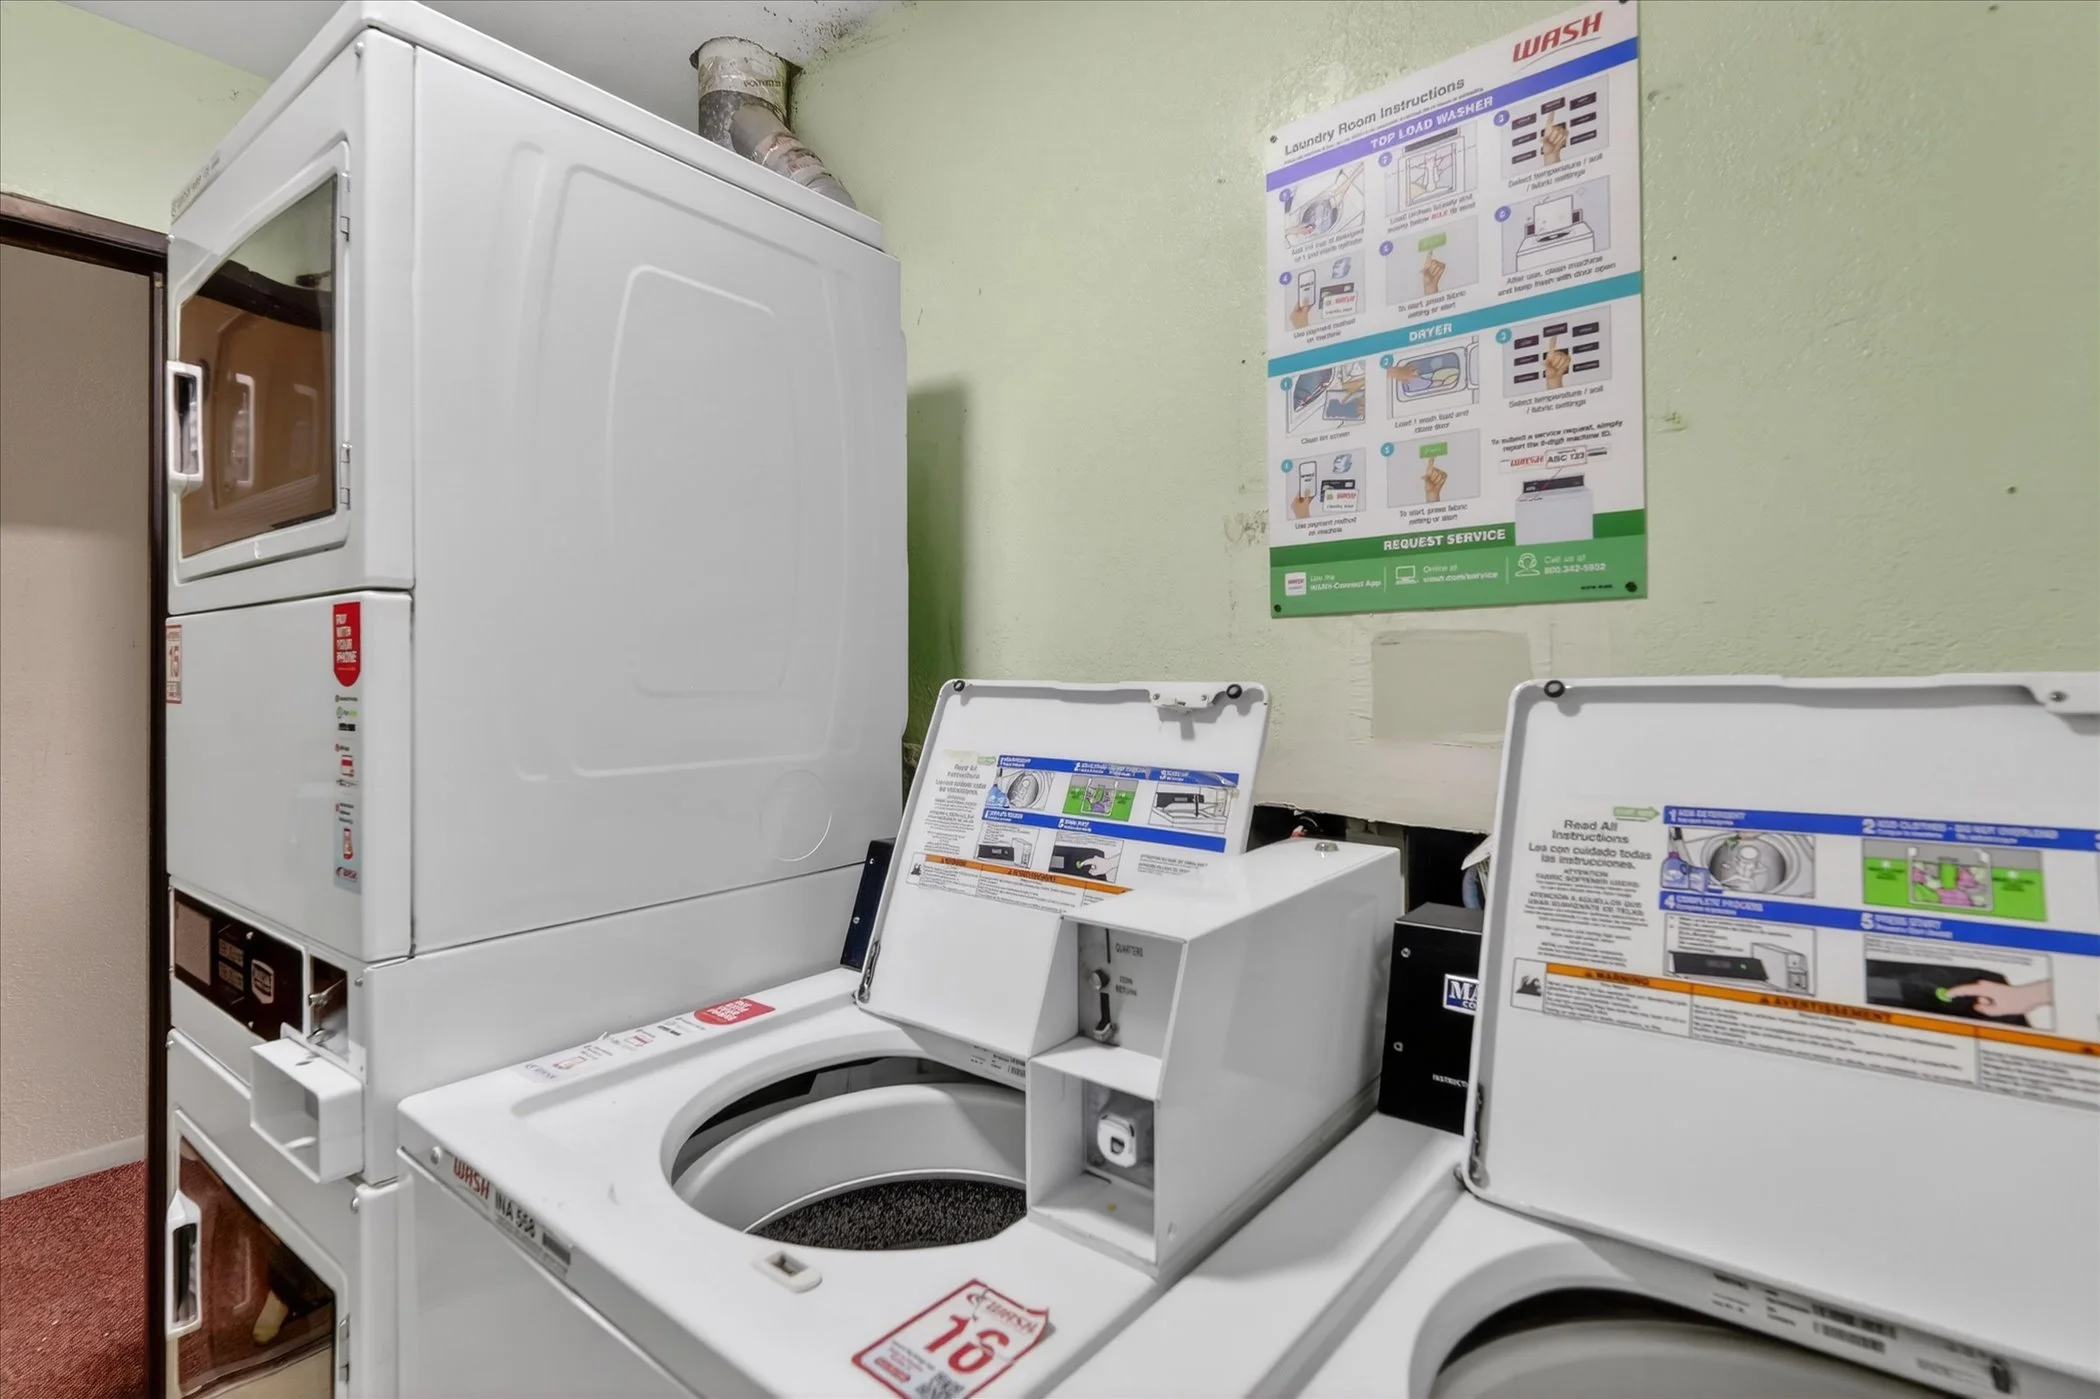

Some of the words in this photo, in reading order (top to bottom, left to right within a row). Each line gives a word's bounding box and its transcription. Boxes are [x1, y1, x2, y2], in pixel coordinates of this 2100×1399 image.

[1513, 11, 1603, 62] WASH
[1285, 129, 1334, 155] Laundry
[1338, 112, 1376, 135] Room
[1381, 79, 1465, 118] Instructions
[1370, 132, 1396, 149] TOP
[1399, 119, 1433, 139] LOAD
[1436, 96, 1493, 125] WASHER
[1498, 287, 1513, 296] and
[1574, 268, 1593, 278] door
[1594, 262, 1616, 273] open
[1408, 323, 1453, 342] DRYER
[1508, 398, 1532, 408] Select
[1535, 430, 1562, 439] service
[1503, 442, 1525, 452] report
[1547, 454, 1567, 463] ABC
[1569, 452, 1585, 460] 123
[1383, 535, 1444, 551] REQUEST
[1447, 529, 1506, 545] SERVICE
[1365, 579, 1381, 588] App
[336, 650, 357, 663] PHONE
[1668, 808, 1678, 823] 1
[1564, 819, 1598, 830] Read
[1601, 821, 1618, 831] All
[1862, 818, 1876, 834] 2
[1552, 829, 1629, 844] Instructions
[1528, 842, 1548, 852] Lea
[1550, 845, 1570, 854] con
[1573, 847, 1617, 858] cuidado
[1620, 849, 1652, 860] todas
[1541, 853, 1556, 863] las
[1559, 855, 1636, 869] instrucciones.
[1663, 894, 1676, 910] 4
[1860, 912, 1874, 929] 5
[1116, 942, 1143, 958] QUARTERS
[1596, 971, 1650, 986] WARNING
[453, 1157, 490, 1200] WASH
[986, 1301, 1038, 1333] WASH
[926, 1314, 1010, 1373] 16
